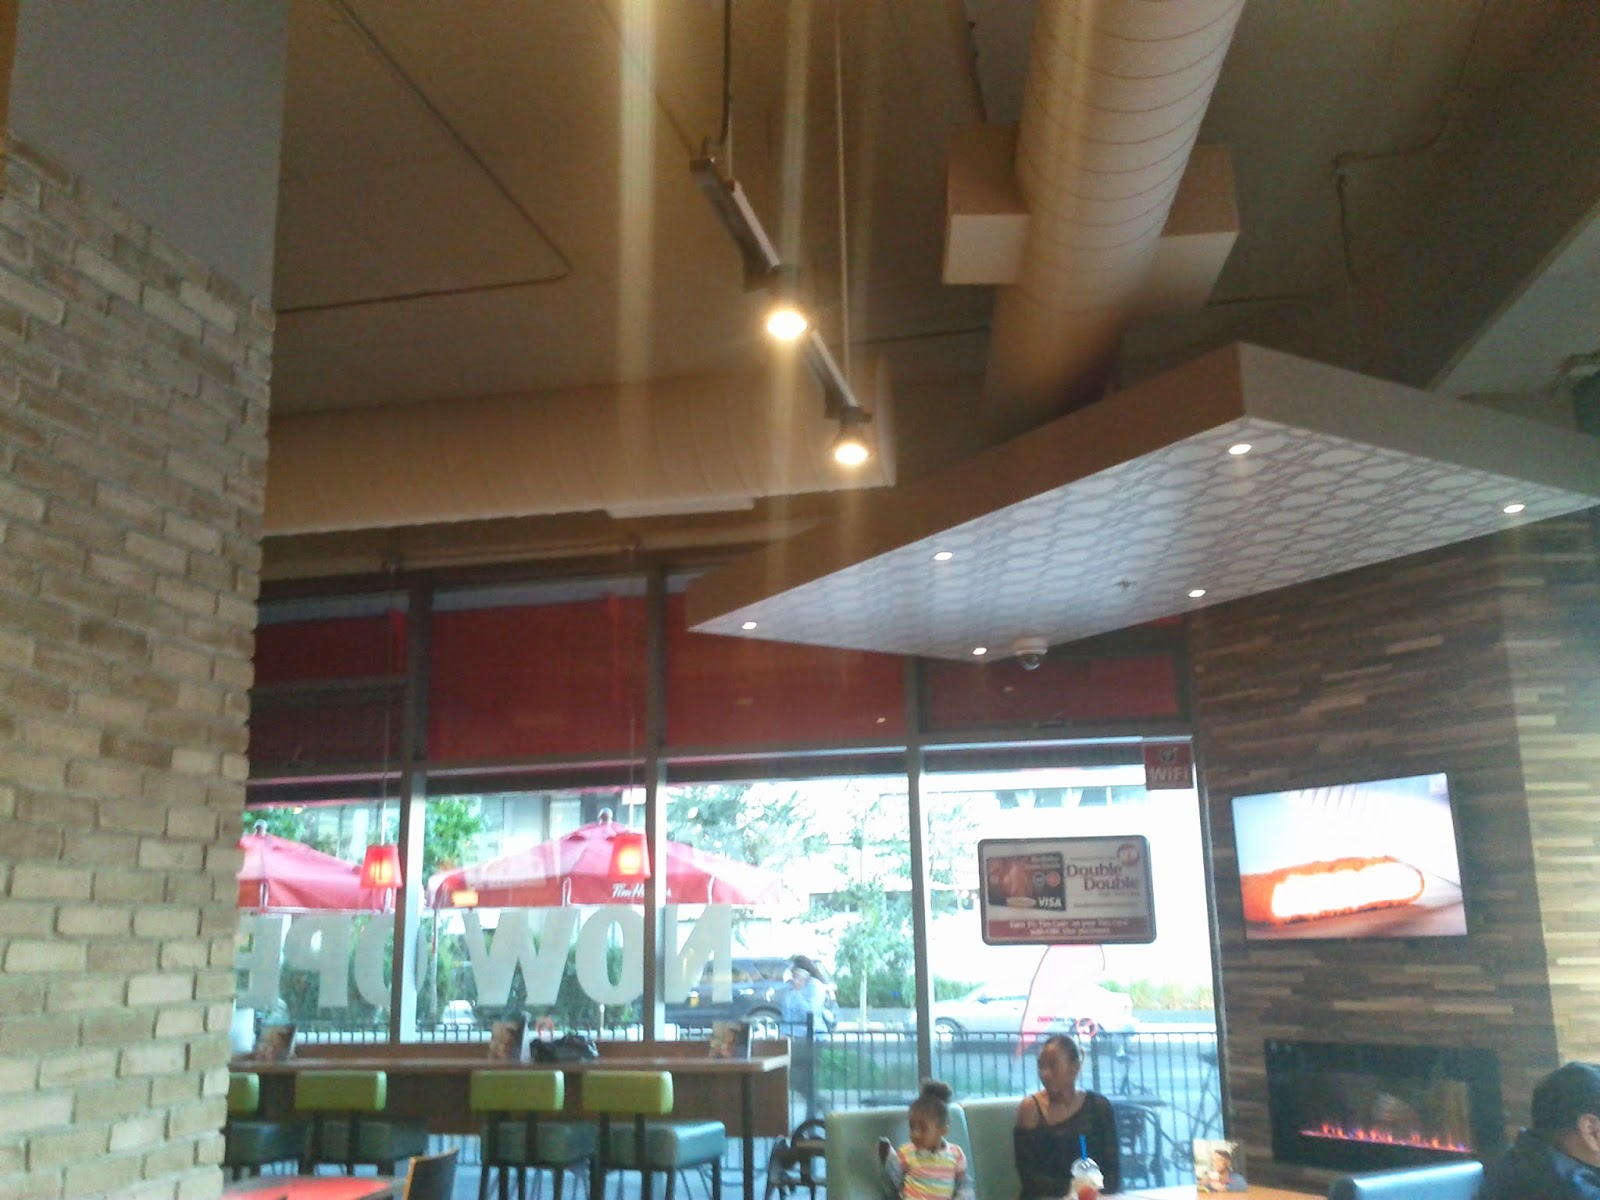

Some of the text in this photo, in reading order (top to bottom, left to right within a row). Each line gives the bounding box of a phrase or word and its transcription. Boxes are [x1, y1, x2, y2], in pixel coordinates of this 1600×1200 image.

[1066, 862, 1123, 878] Double
[1083, 876, 1139, 891] Double
[1037, 896, 1063, 908] VISA
